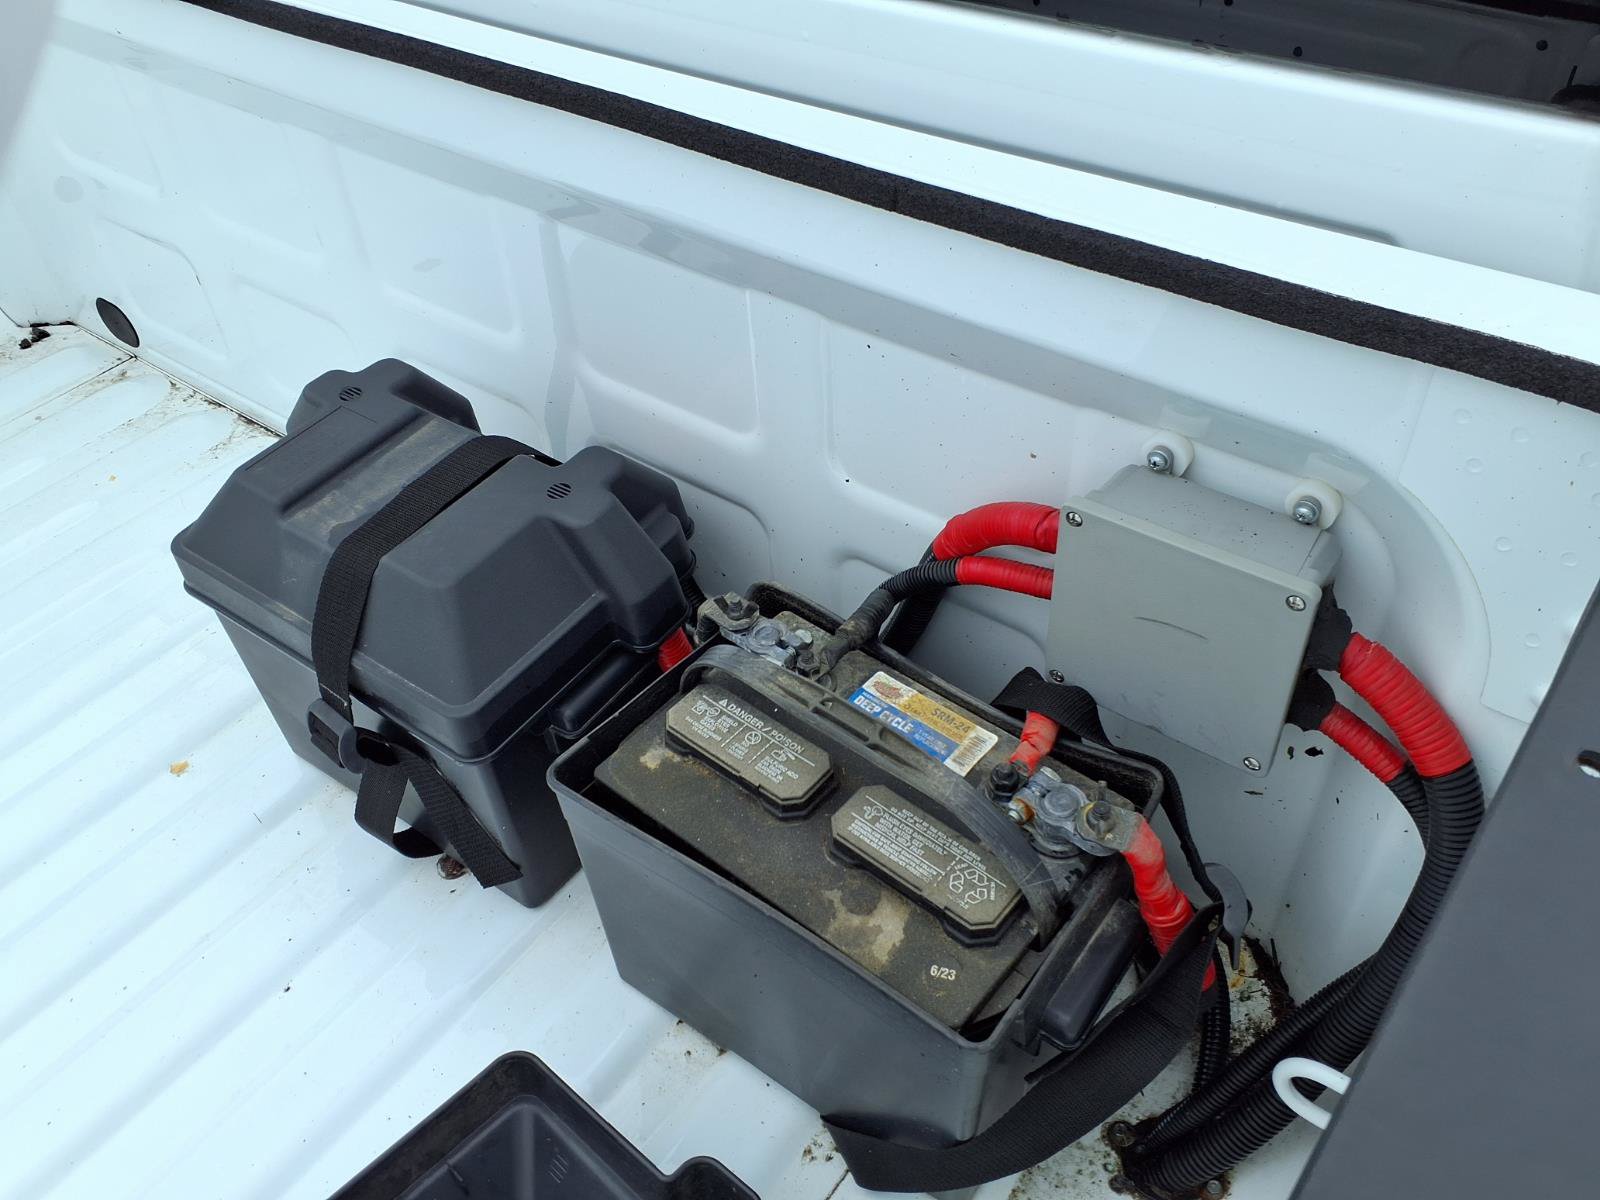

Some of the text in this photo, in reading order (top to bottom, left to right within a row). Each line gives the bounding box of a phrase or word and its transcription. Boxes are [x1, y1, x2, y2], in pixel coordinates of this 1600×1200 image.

[728, 703, 764, 729] DANGER
[770, 729, 805, 754] POISON
[853, 695, 881, 714] DEEP
[879, 710, 913, 734] CYCLE
[931, 708, 971, 734] SRM-24
[930, 965, 956, 981] 6/23
